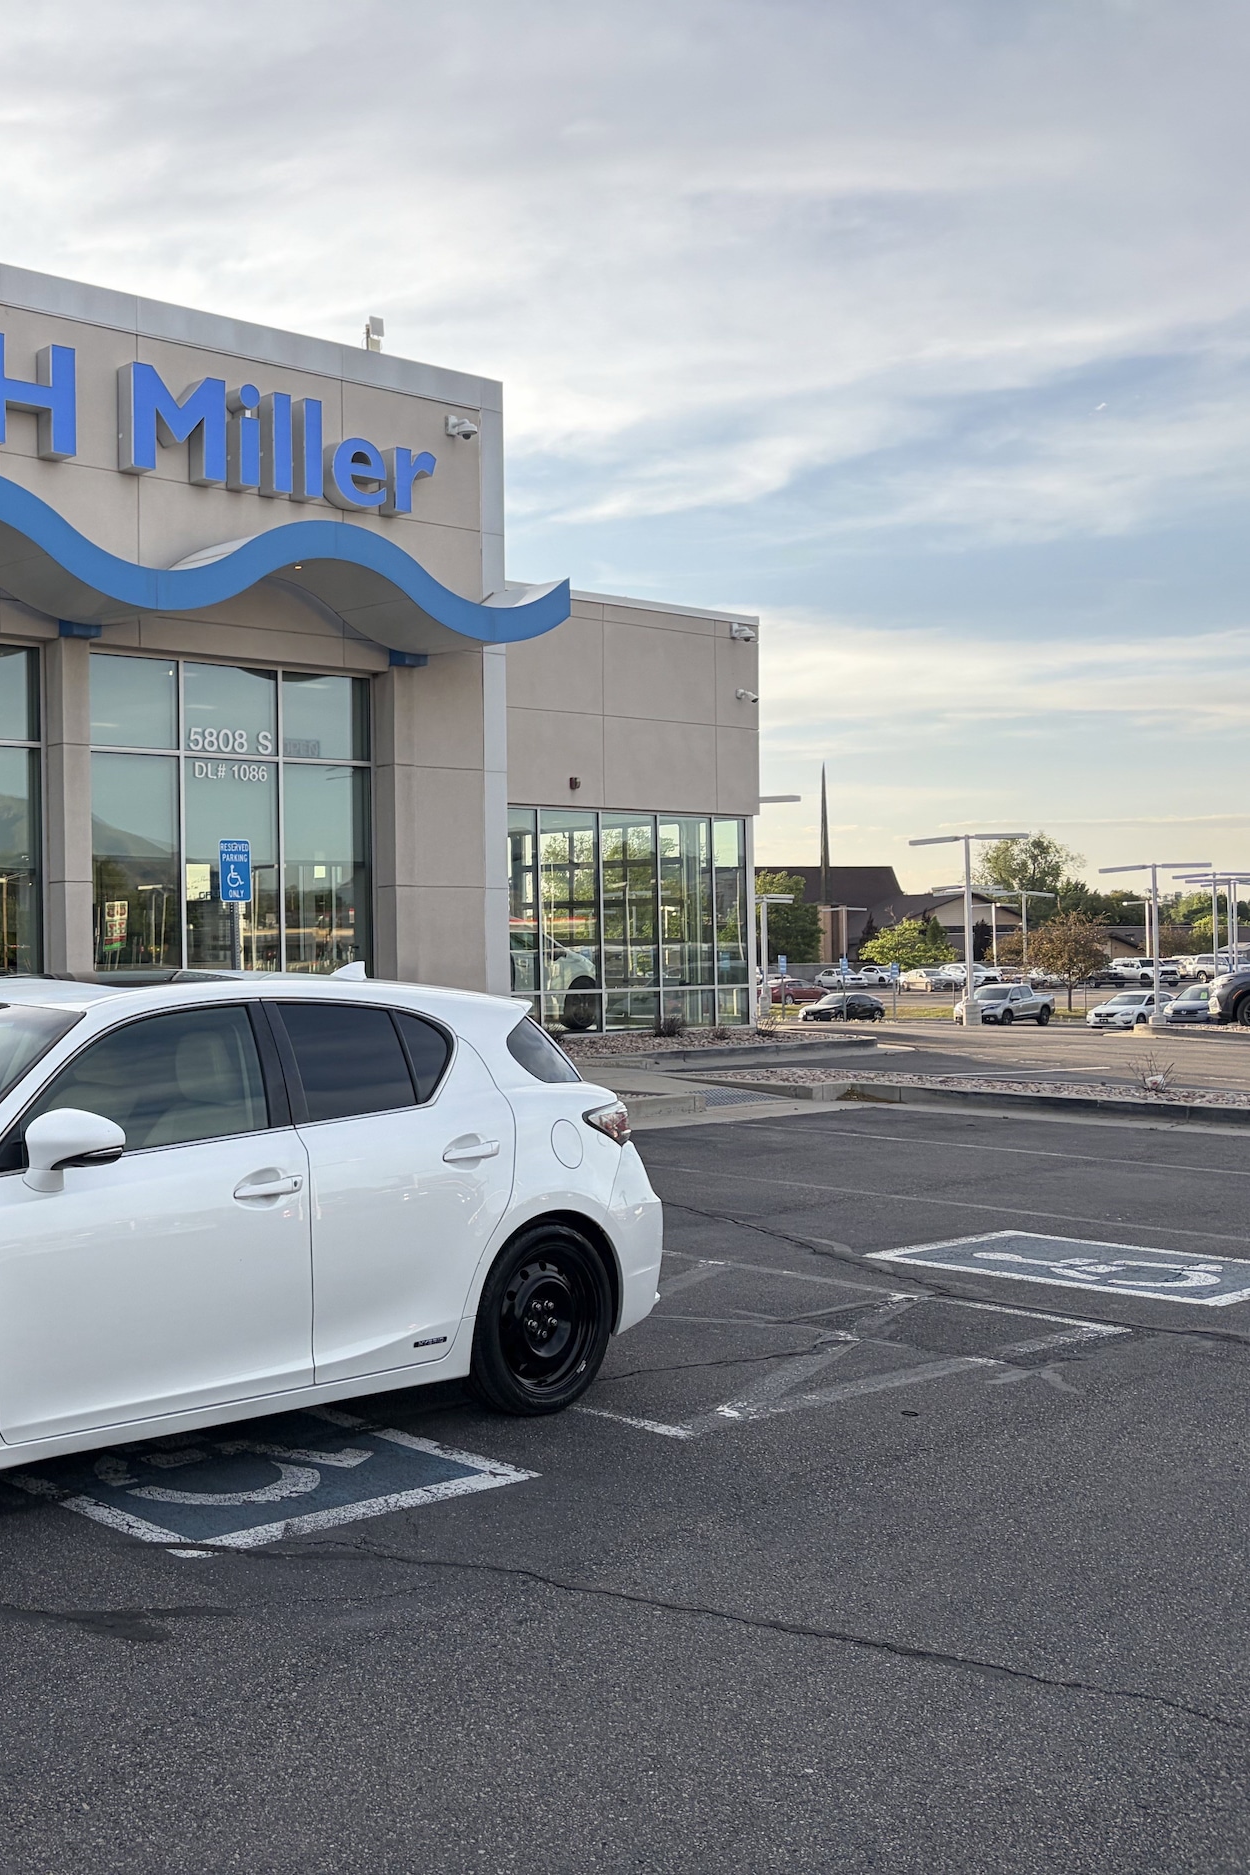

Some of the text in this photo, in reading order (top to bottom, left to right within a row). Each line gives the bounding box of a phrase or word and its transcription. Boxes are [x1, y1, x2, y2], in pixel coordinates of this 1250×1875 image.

[119, 361, 436, 515] Miller
[189, 727, 272, 755] 5808 S
[194, 761, 268, 782] DL# 1086
[220, 842, 249, 852] RESERVED
[222, 853, 248, 862] PARKING
[228, 889, 244, 898] ONLY
